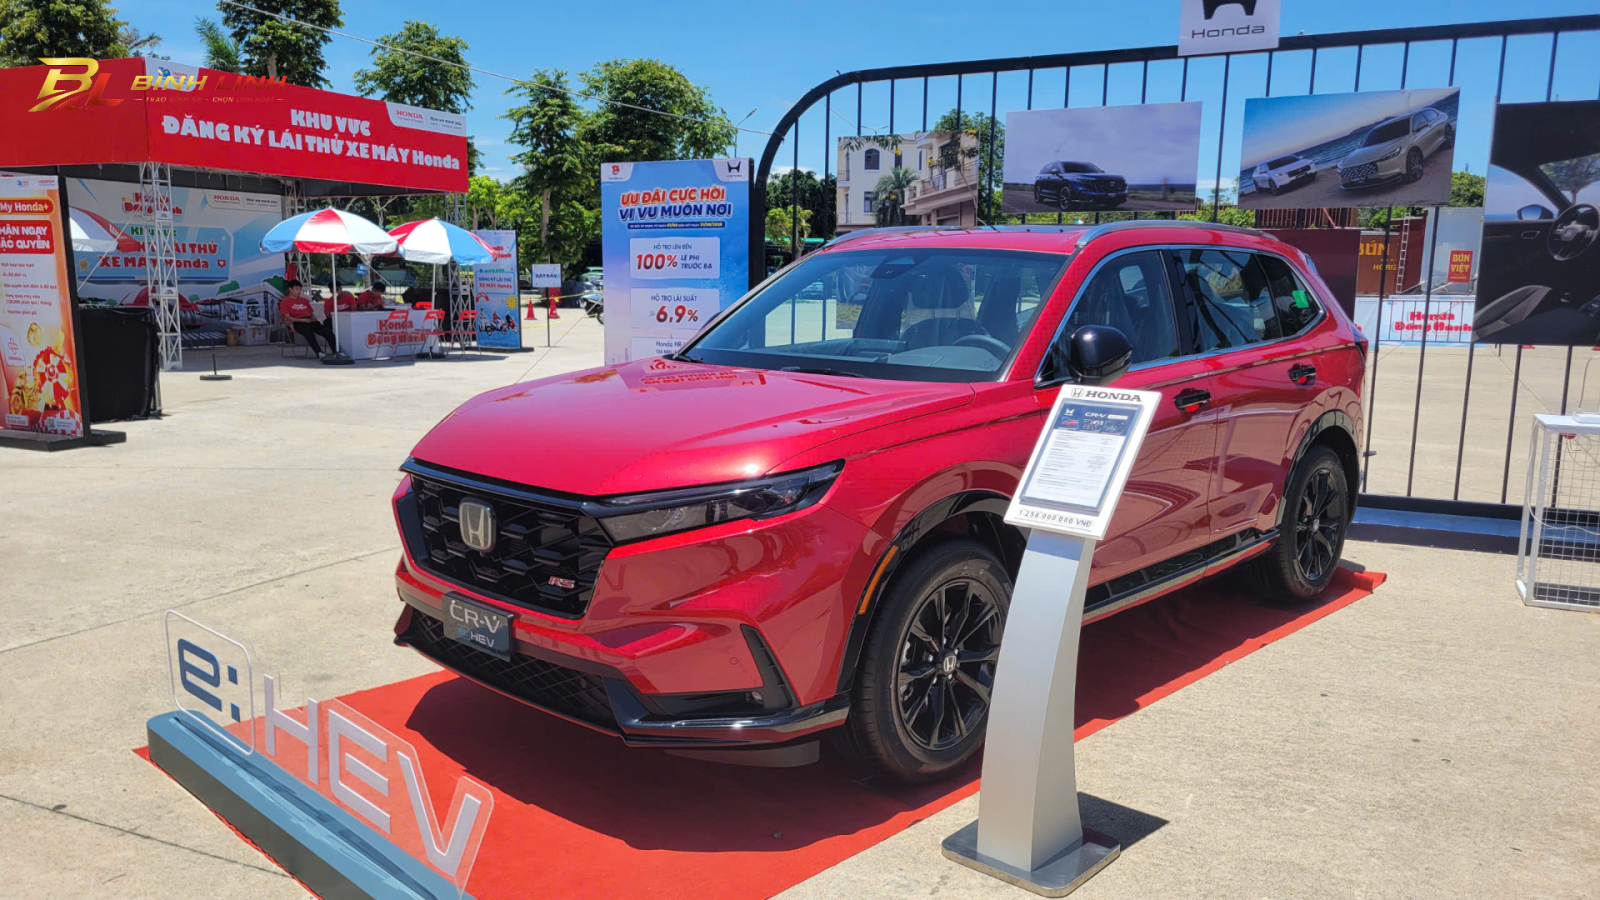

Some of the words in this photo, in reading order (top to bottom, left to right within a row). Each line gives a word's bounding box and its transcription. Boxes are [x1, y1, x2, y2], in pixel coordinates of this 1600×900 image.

[1191, 25, 1265, 39] Honda
[396, 110, 424, 119] HONDA
[290, 109, 333, 131] KHU
[335, 115, 371, 137] VỰC
[162, 113, 231, 141] ĐĂNG
[233, 124, 265, 145] KÝ
[268, 129, 303, 151] LÁI
[305, 134, 345, 156] THỬ
[345, 141, 370, 159] XE
[371, 144, 411, 163] MÁY
[412, 150, 460, 170] Honda
[621, 192, 640, 206] ƯU
[642, 188, 666, 204] ĐÃI
[669, 188, 698, 204] CỰC
[700, 185, 725, 201] HỜI
[0, 202, 13, 214] My
[14, 201, 49, 211] Honda+
[620, 208, 635, 220] VI
[638, 206, 658, 218] VU
[660, 202, 703, 218] MUÔN
[706, 203, 732, 216] NƠI
[99, 256, 121, 268] XE
[636, 253, 678, 270] 100%
[1452, 253, 1471, 262] BÚN
[1450, 263, 1470, 273] VIỆT
[1085, 390, 1142, 402] HONDA
[548, 575, 575, 589] RS
[450, 602, 501, 634] CR-V
